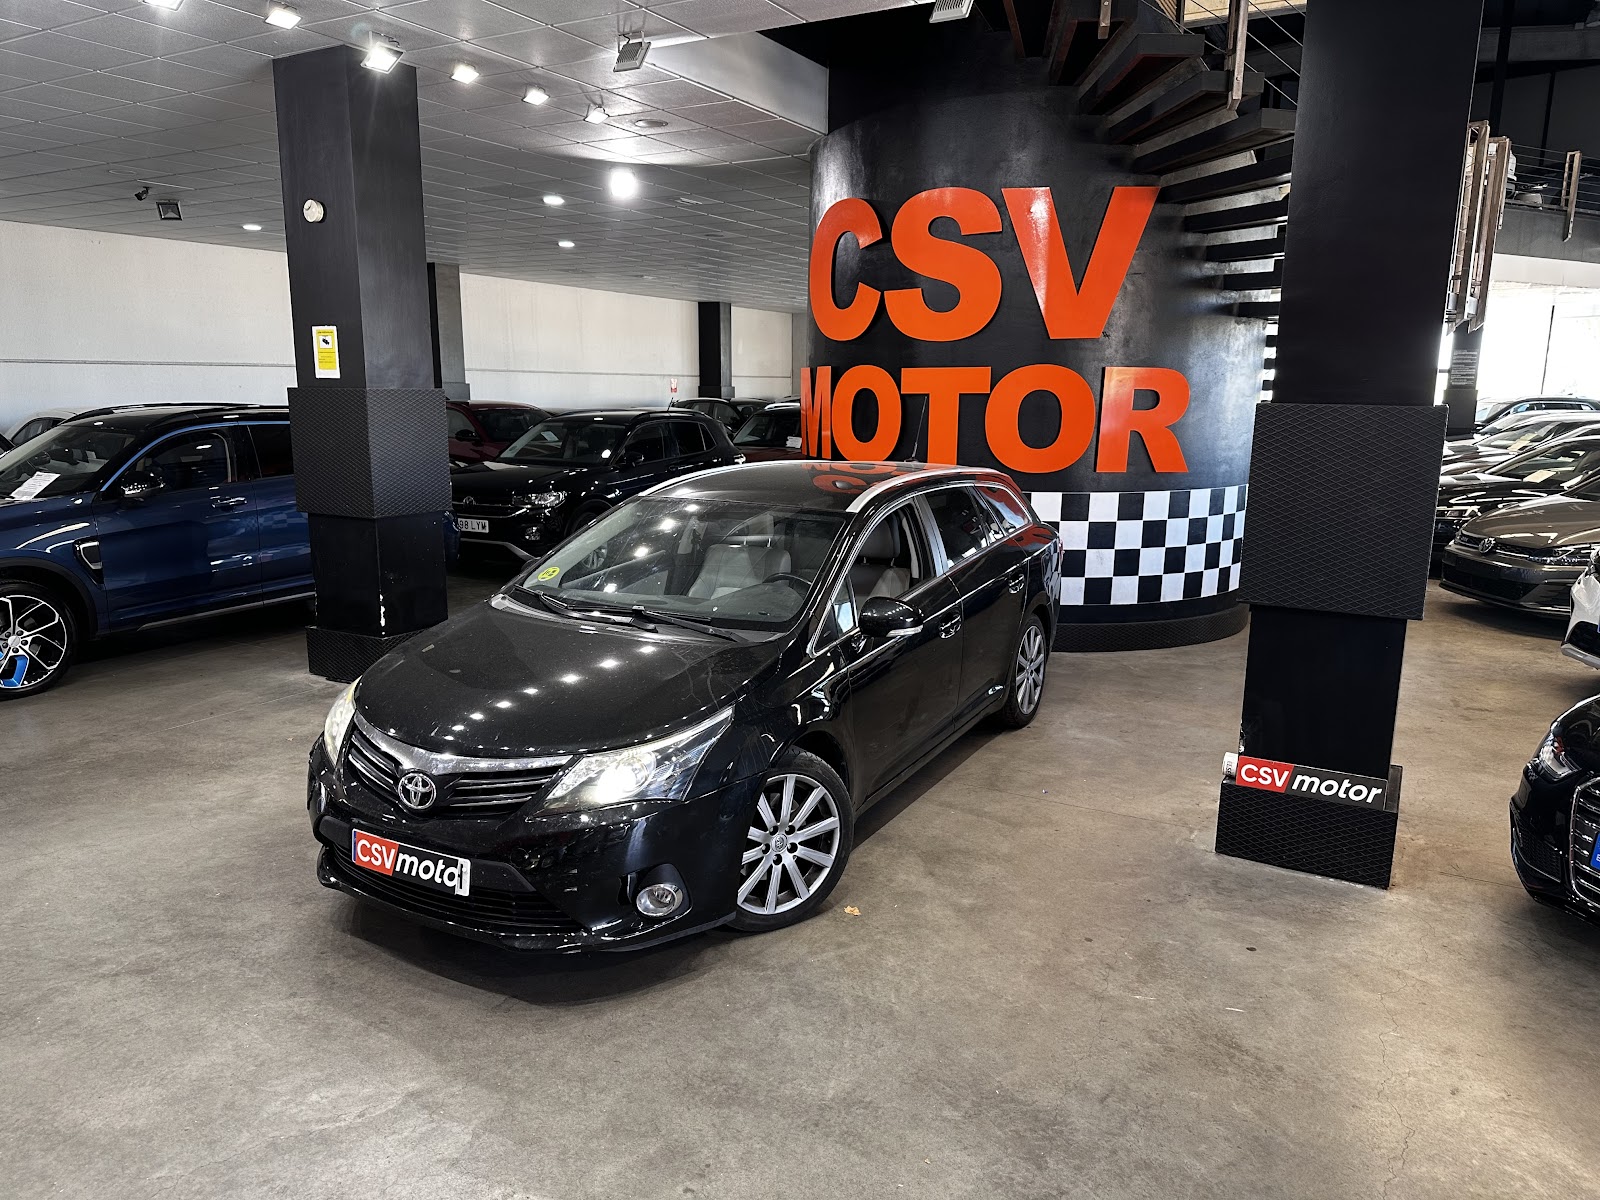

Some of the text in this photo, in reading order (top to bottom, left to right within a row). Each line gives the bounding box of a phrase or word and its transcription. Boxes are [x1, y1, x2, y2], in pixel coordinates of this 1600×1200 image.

[809, 186, 1161, 342] CSV
[800, 363, 1191, 473] MOTOR
[1240, 763, 1290, 788] CSV
[1291, 773, 1383, 804] motor
[357, 839, 460, 887] CSV moto
